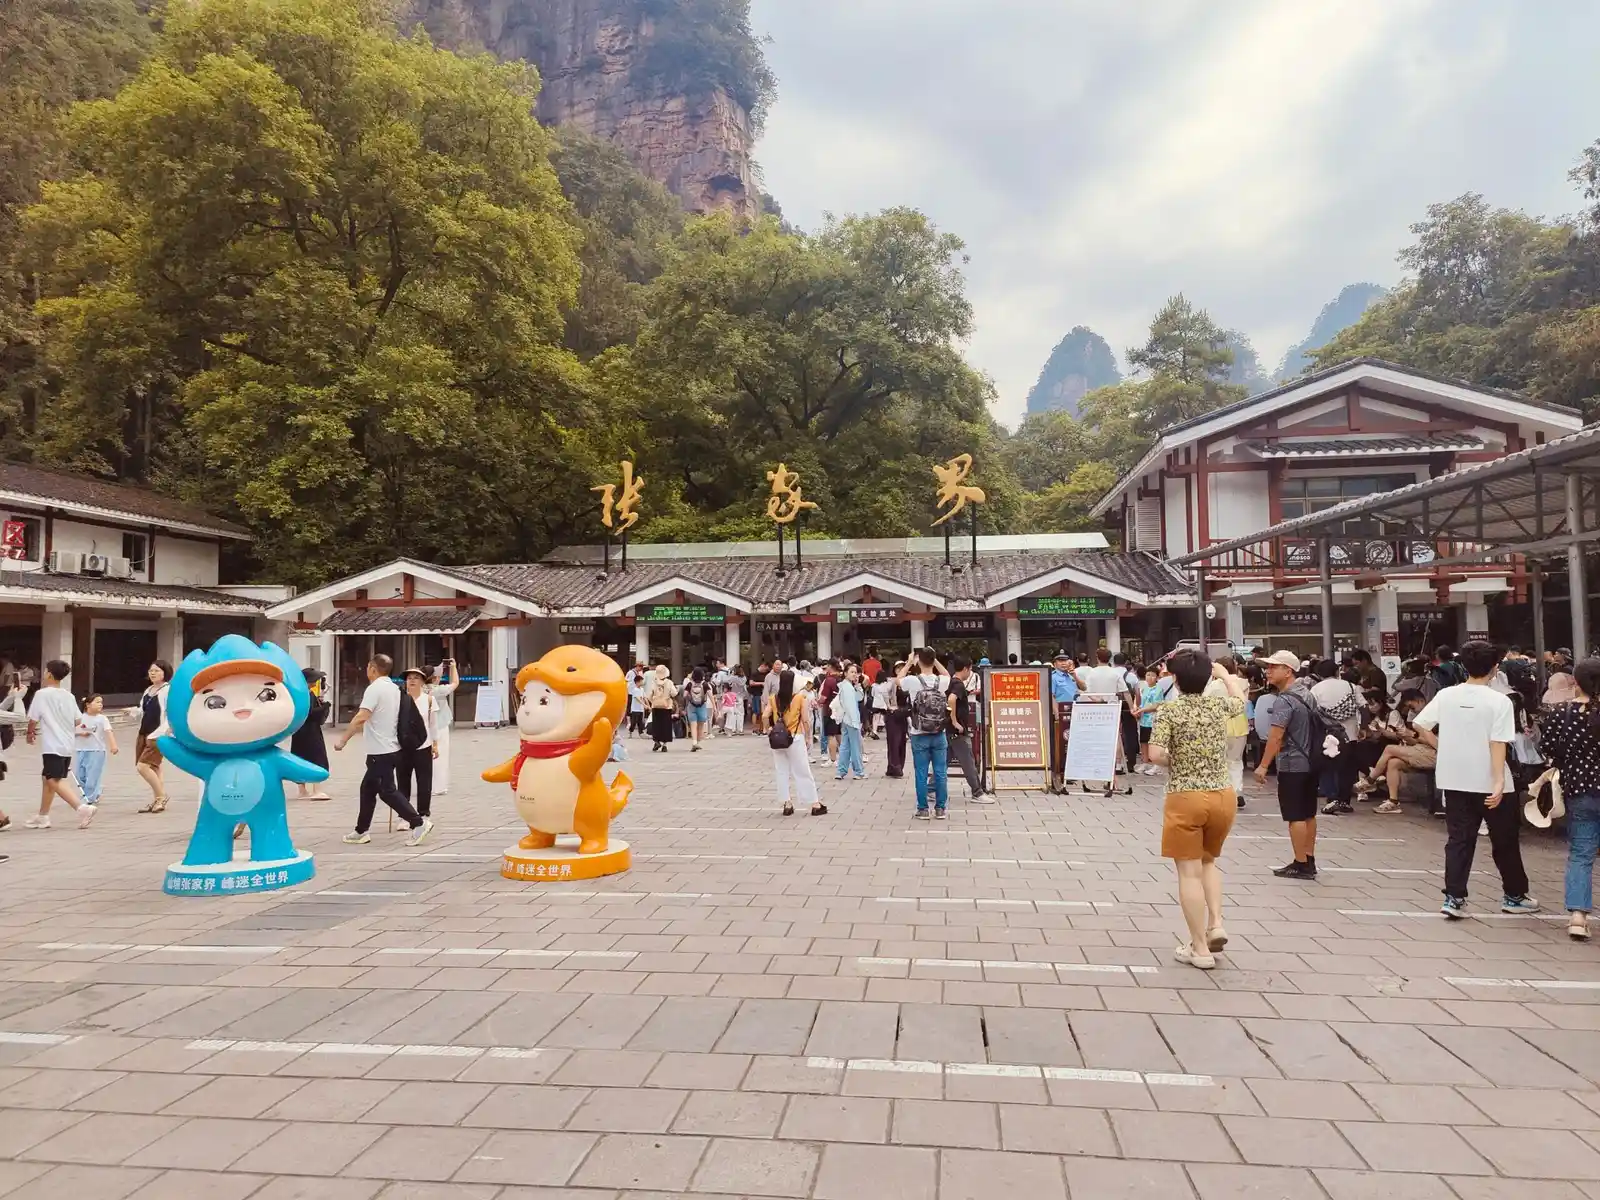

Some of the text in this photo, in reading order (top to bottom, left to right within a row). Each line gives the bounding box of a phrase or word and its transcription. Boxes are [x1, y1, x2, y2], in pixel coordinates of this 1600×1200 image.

[1000, 707, 1033, 716] 温馨提示
[516, 863, 573, 877] 峰迷全世界
[221, 870, 289, 890] 峰迷全世界
